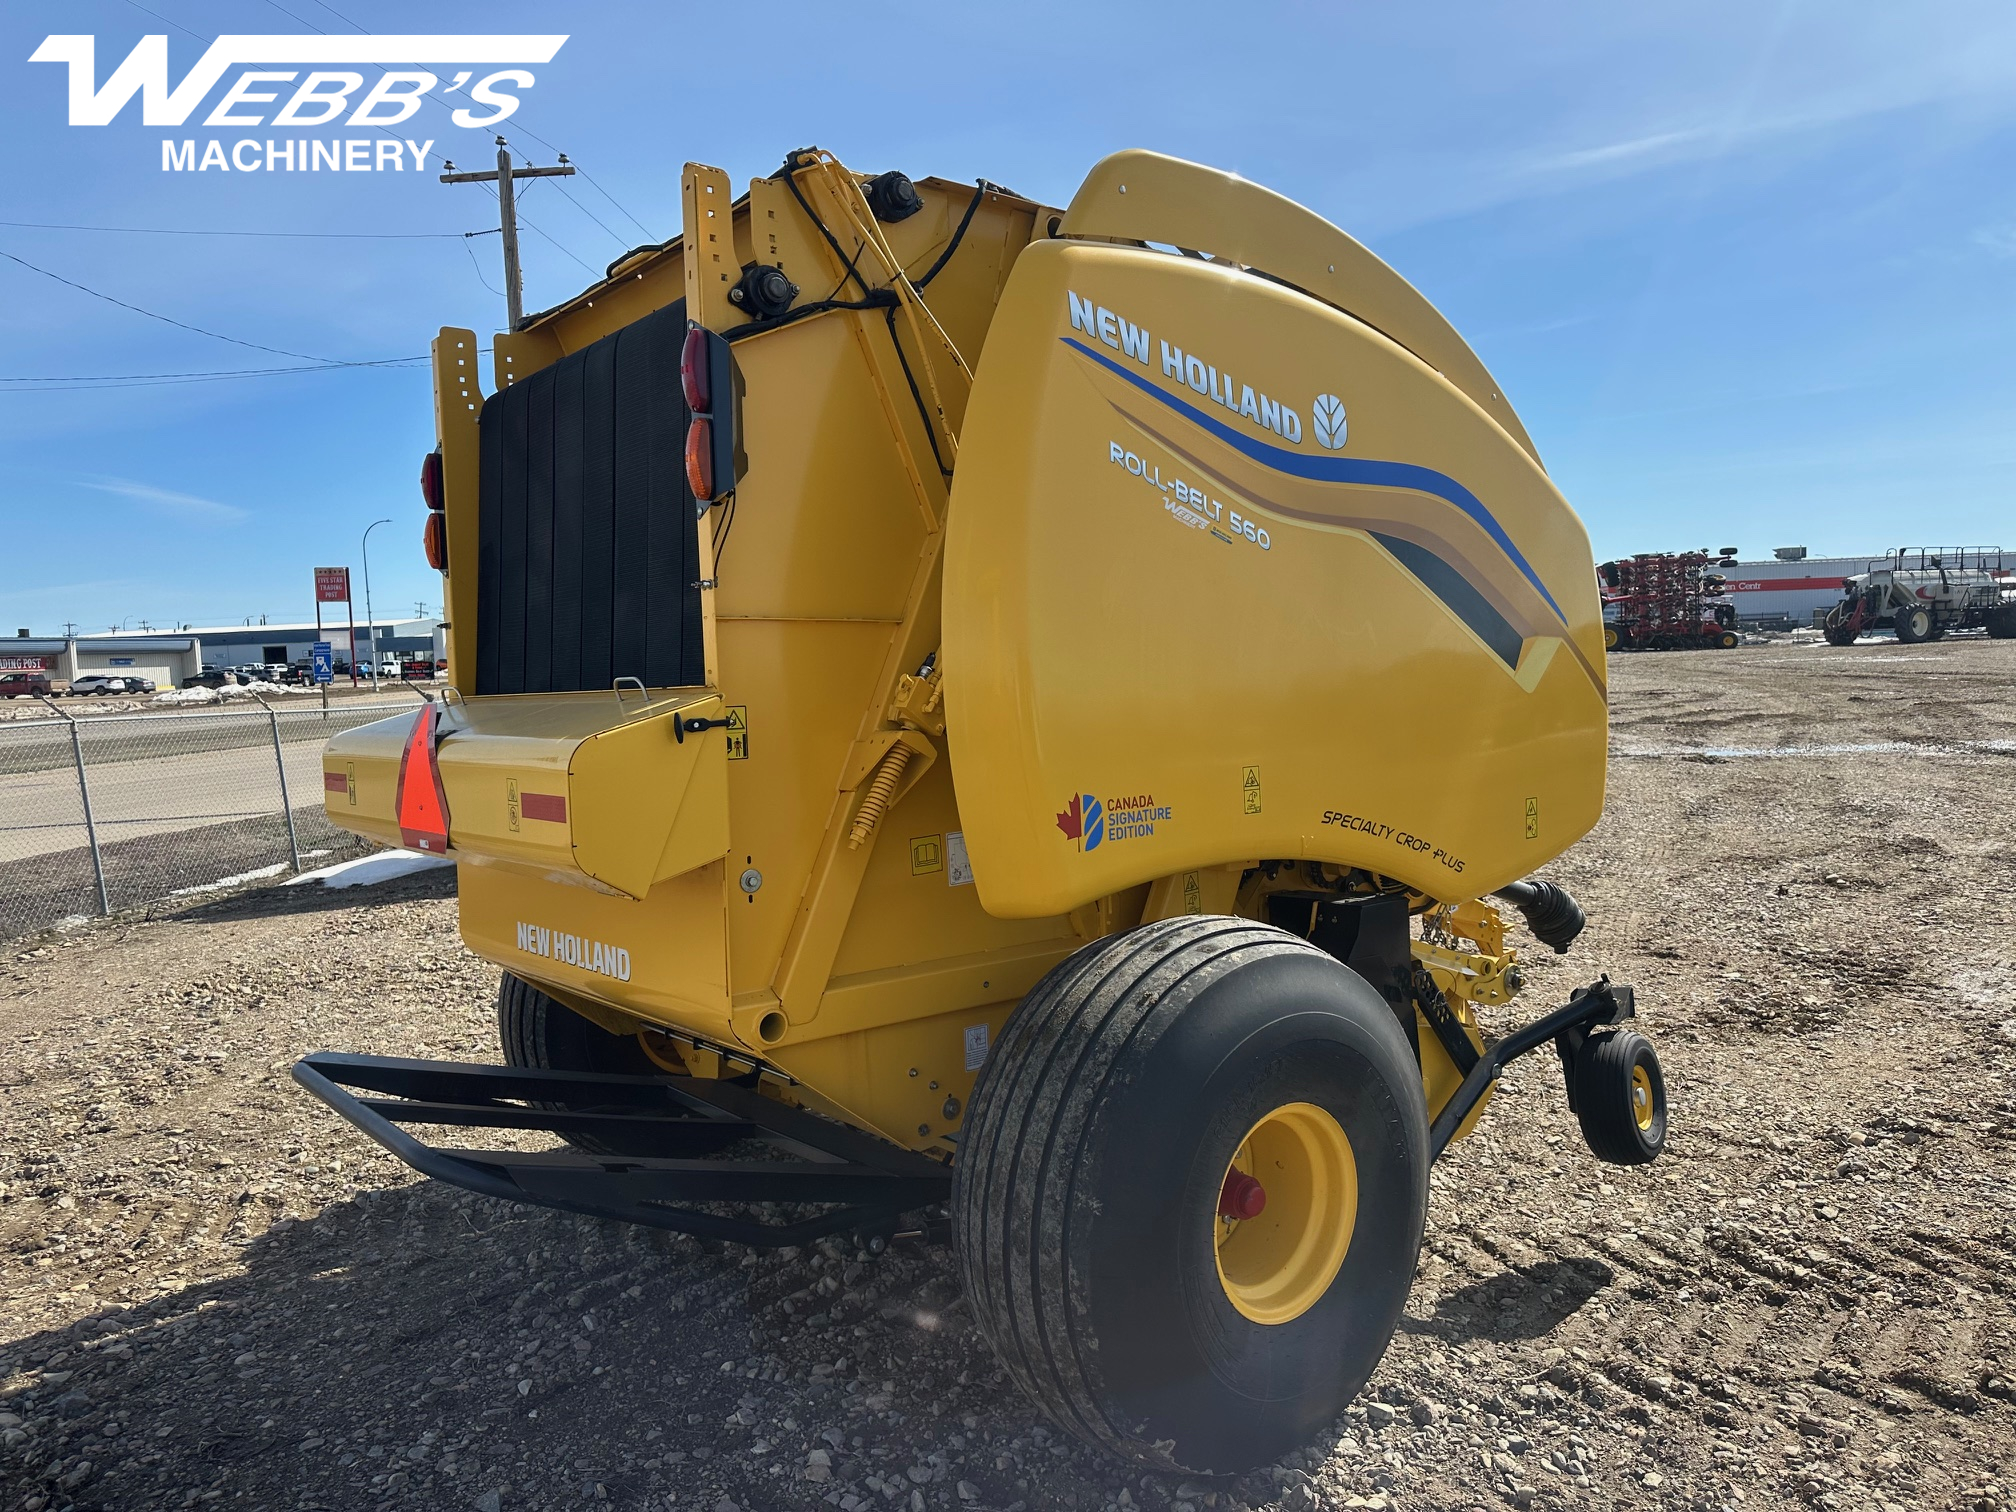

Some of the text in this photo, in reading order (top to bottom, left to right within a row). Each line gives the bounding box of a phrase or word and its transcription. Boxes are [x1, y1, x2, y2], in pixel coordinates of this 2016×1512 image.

[1067, 289, 1303, 445] NEW HOLLAND
[1109, 440, 1271, 550] ROLL-BELT 560
[22, 658, 42, 669] POST
[1107, 795, 1155, 812] CANADA
[1108, 807, 1172, 826] SIGNATURE
[1108, 823, 1154, 841] EDITION
[1321, 810, 1395, 840] SPECIALTY
[1395, 831, 1431, 853] CROP
[517, 921, 631, 982] NEW HOLLAND
